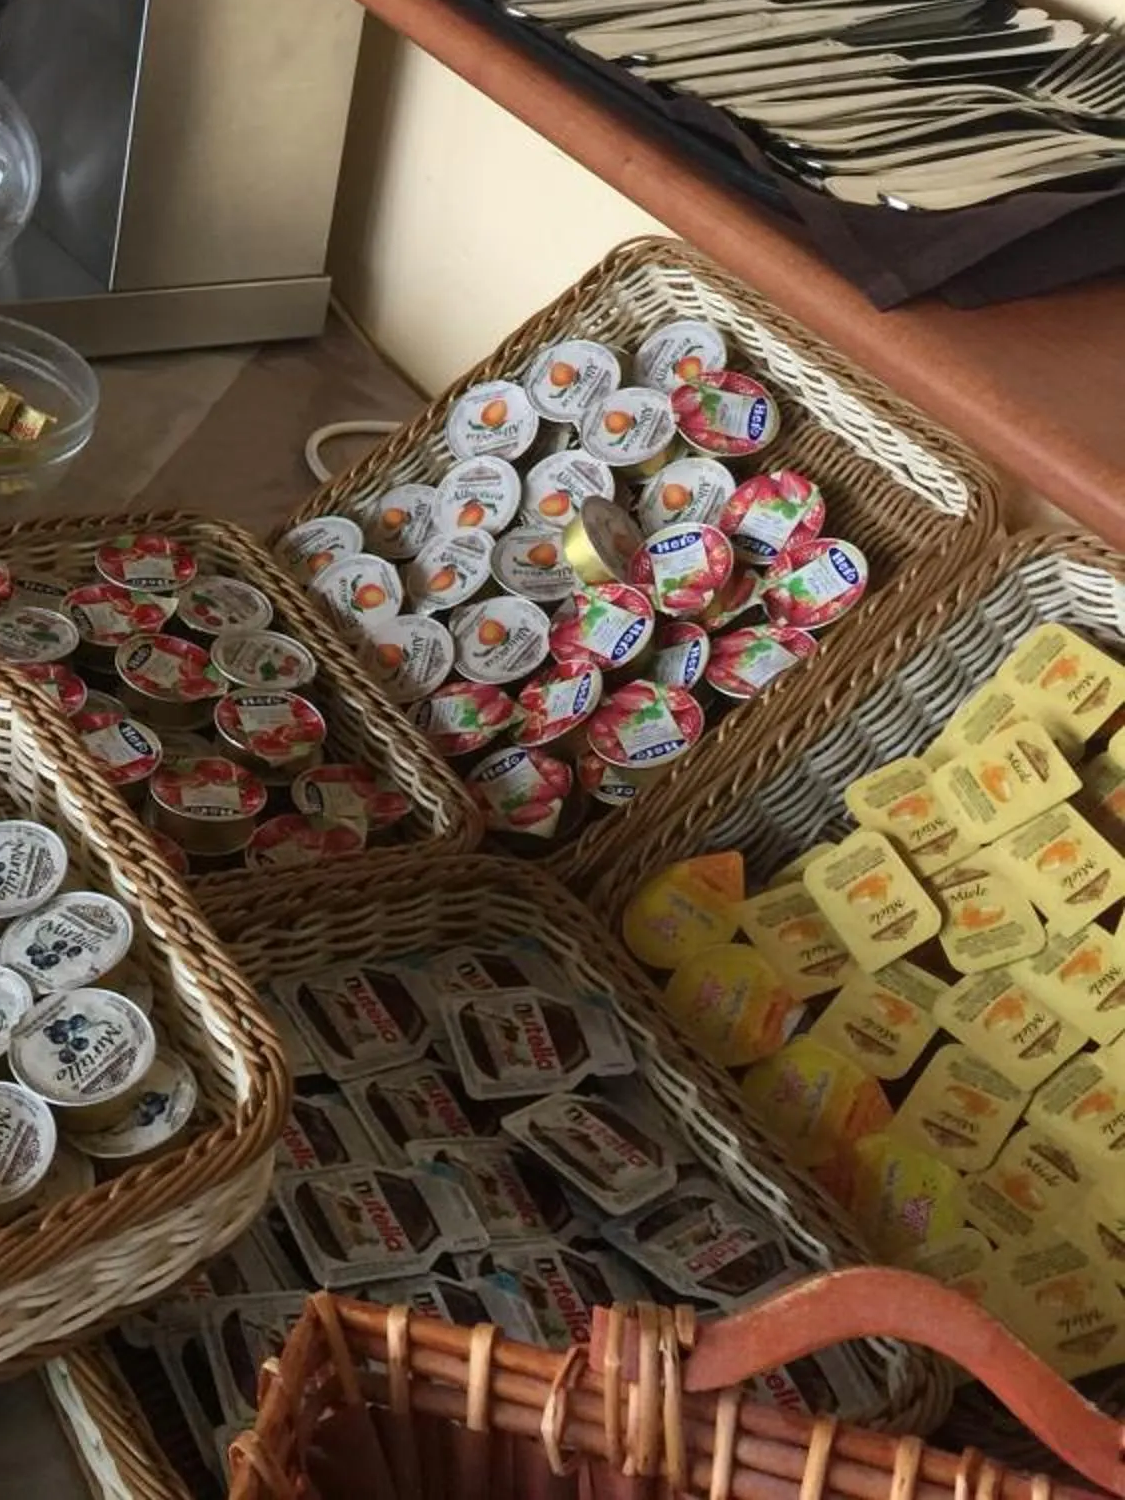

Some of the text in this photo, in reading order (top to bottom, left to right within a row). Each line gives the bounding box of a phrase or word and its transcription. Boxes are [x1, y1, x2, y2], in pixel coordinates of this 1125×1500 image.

[750, 402, 767, 438] Hero
[656, 533, 697, 553] Hero
[831, 555, 857, 581] Hero
[614, 622, 644, 657] Hero
[634, 741, 679, 760] Hero
[950, 884, 987, 902] Miele
[344, 976, 398, 1044] nutella
[56, 1020, 124, 1090] Mirtillo
[514, 1002, 554, 1071] nutella
[564, 1106, 648, 1169] nutella
[351, 1180, 405, 1253] nutella
[534, 1257, 591, 1345] nutella
